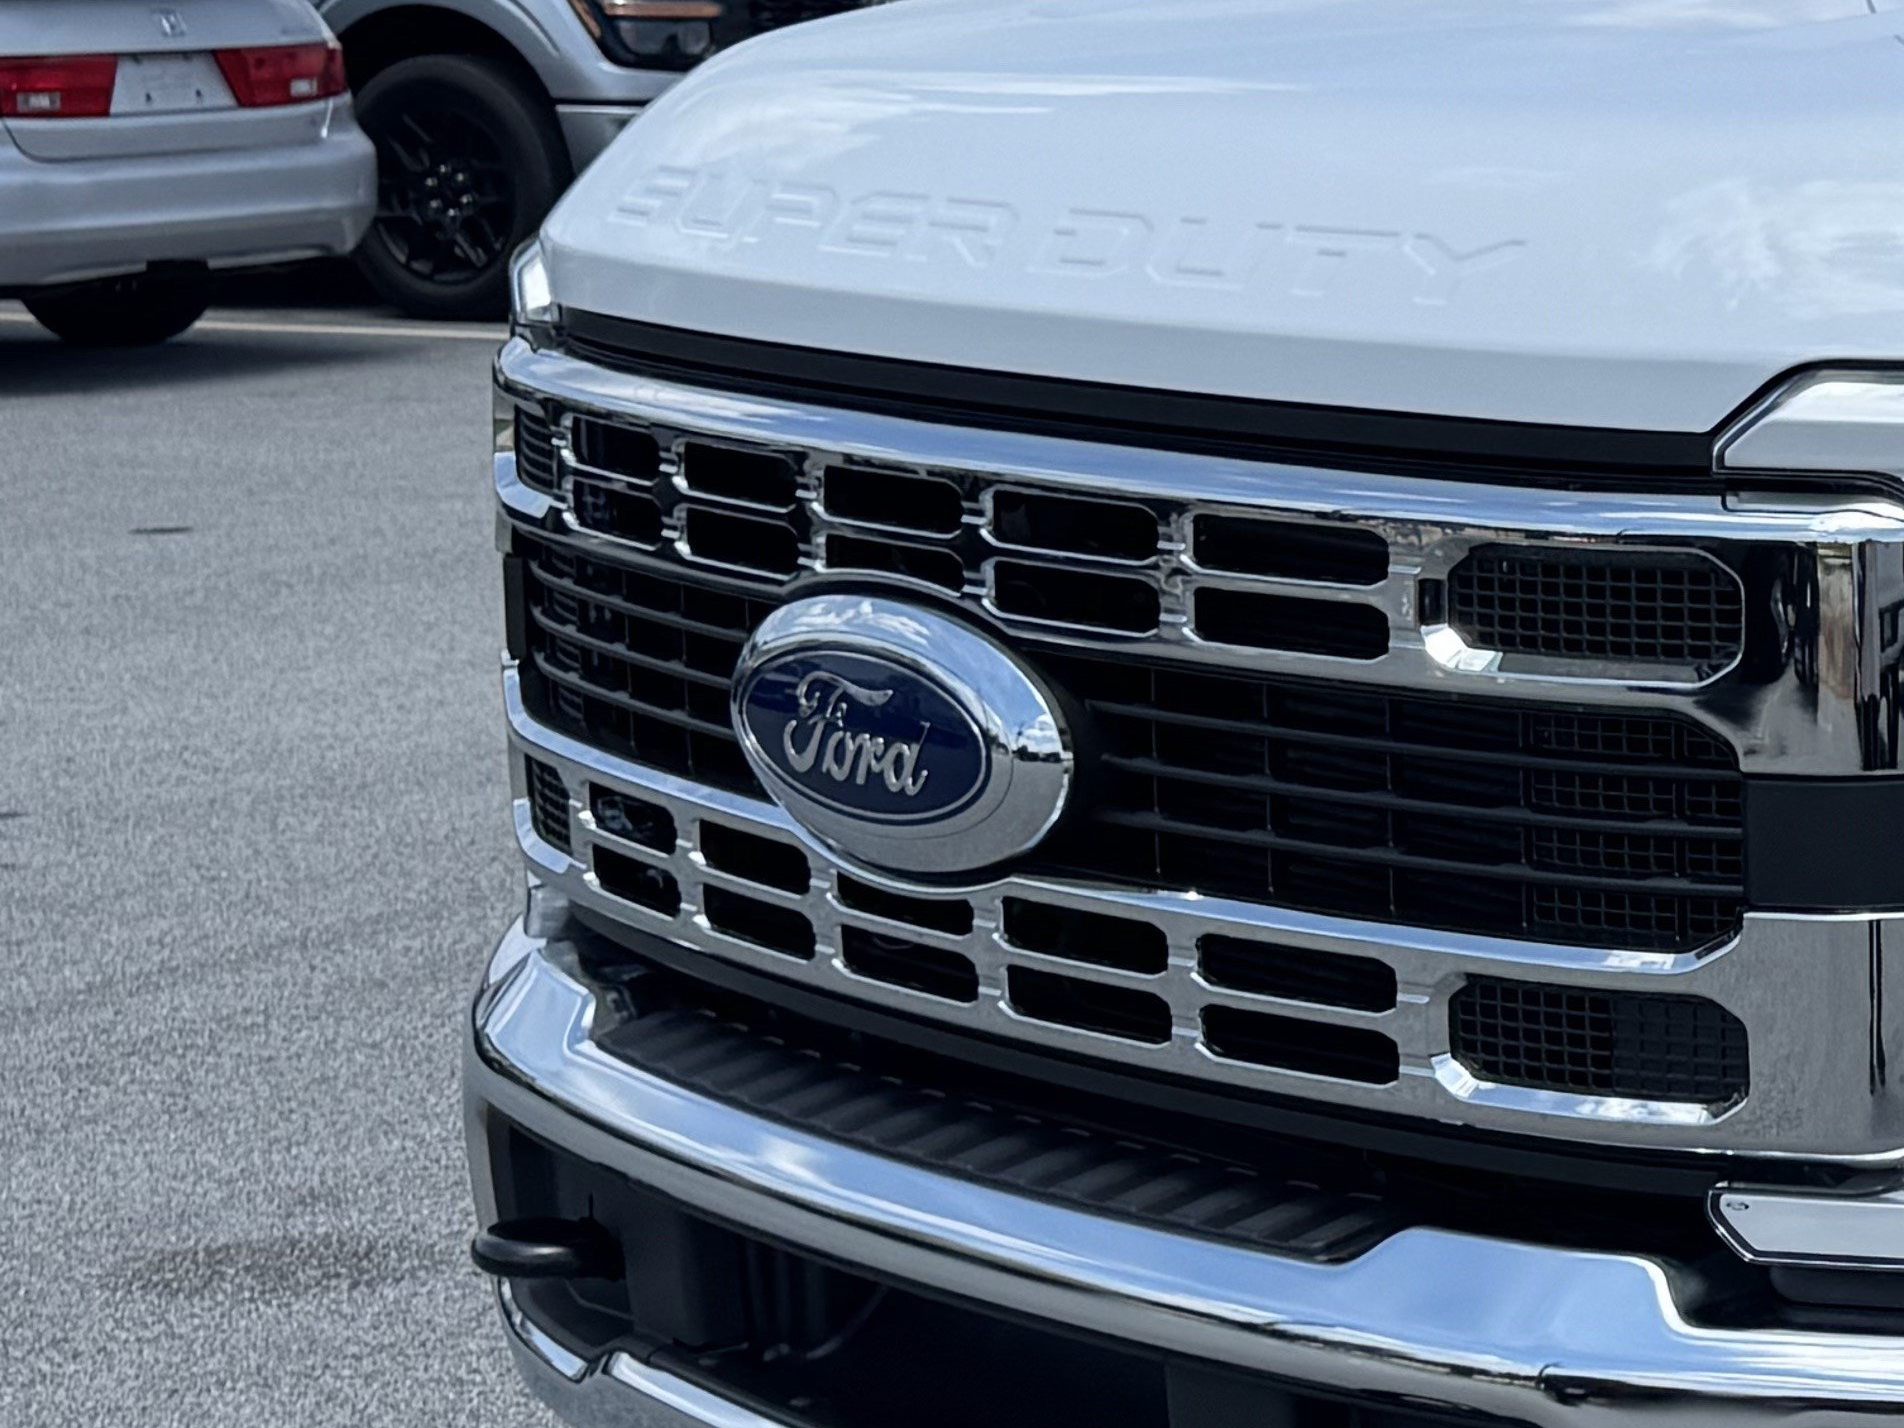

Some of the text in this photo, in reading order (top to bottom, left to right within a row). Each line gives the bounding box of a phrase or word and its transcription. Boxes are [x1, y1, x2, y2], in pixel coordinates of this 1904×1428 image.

[613, 167, 1528, 304] SUPER DUTY
[782, 671, 930, 796] Ford
